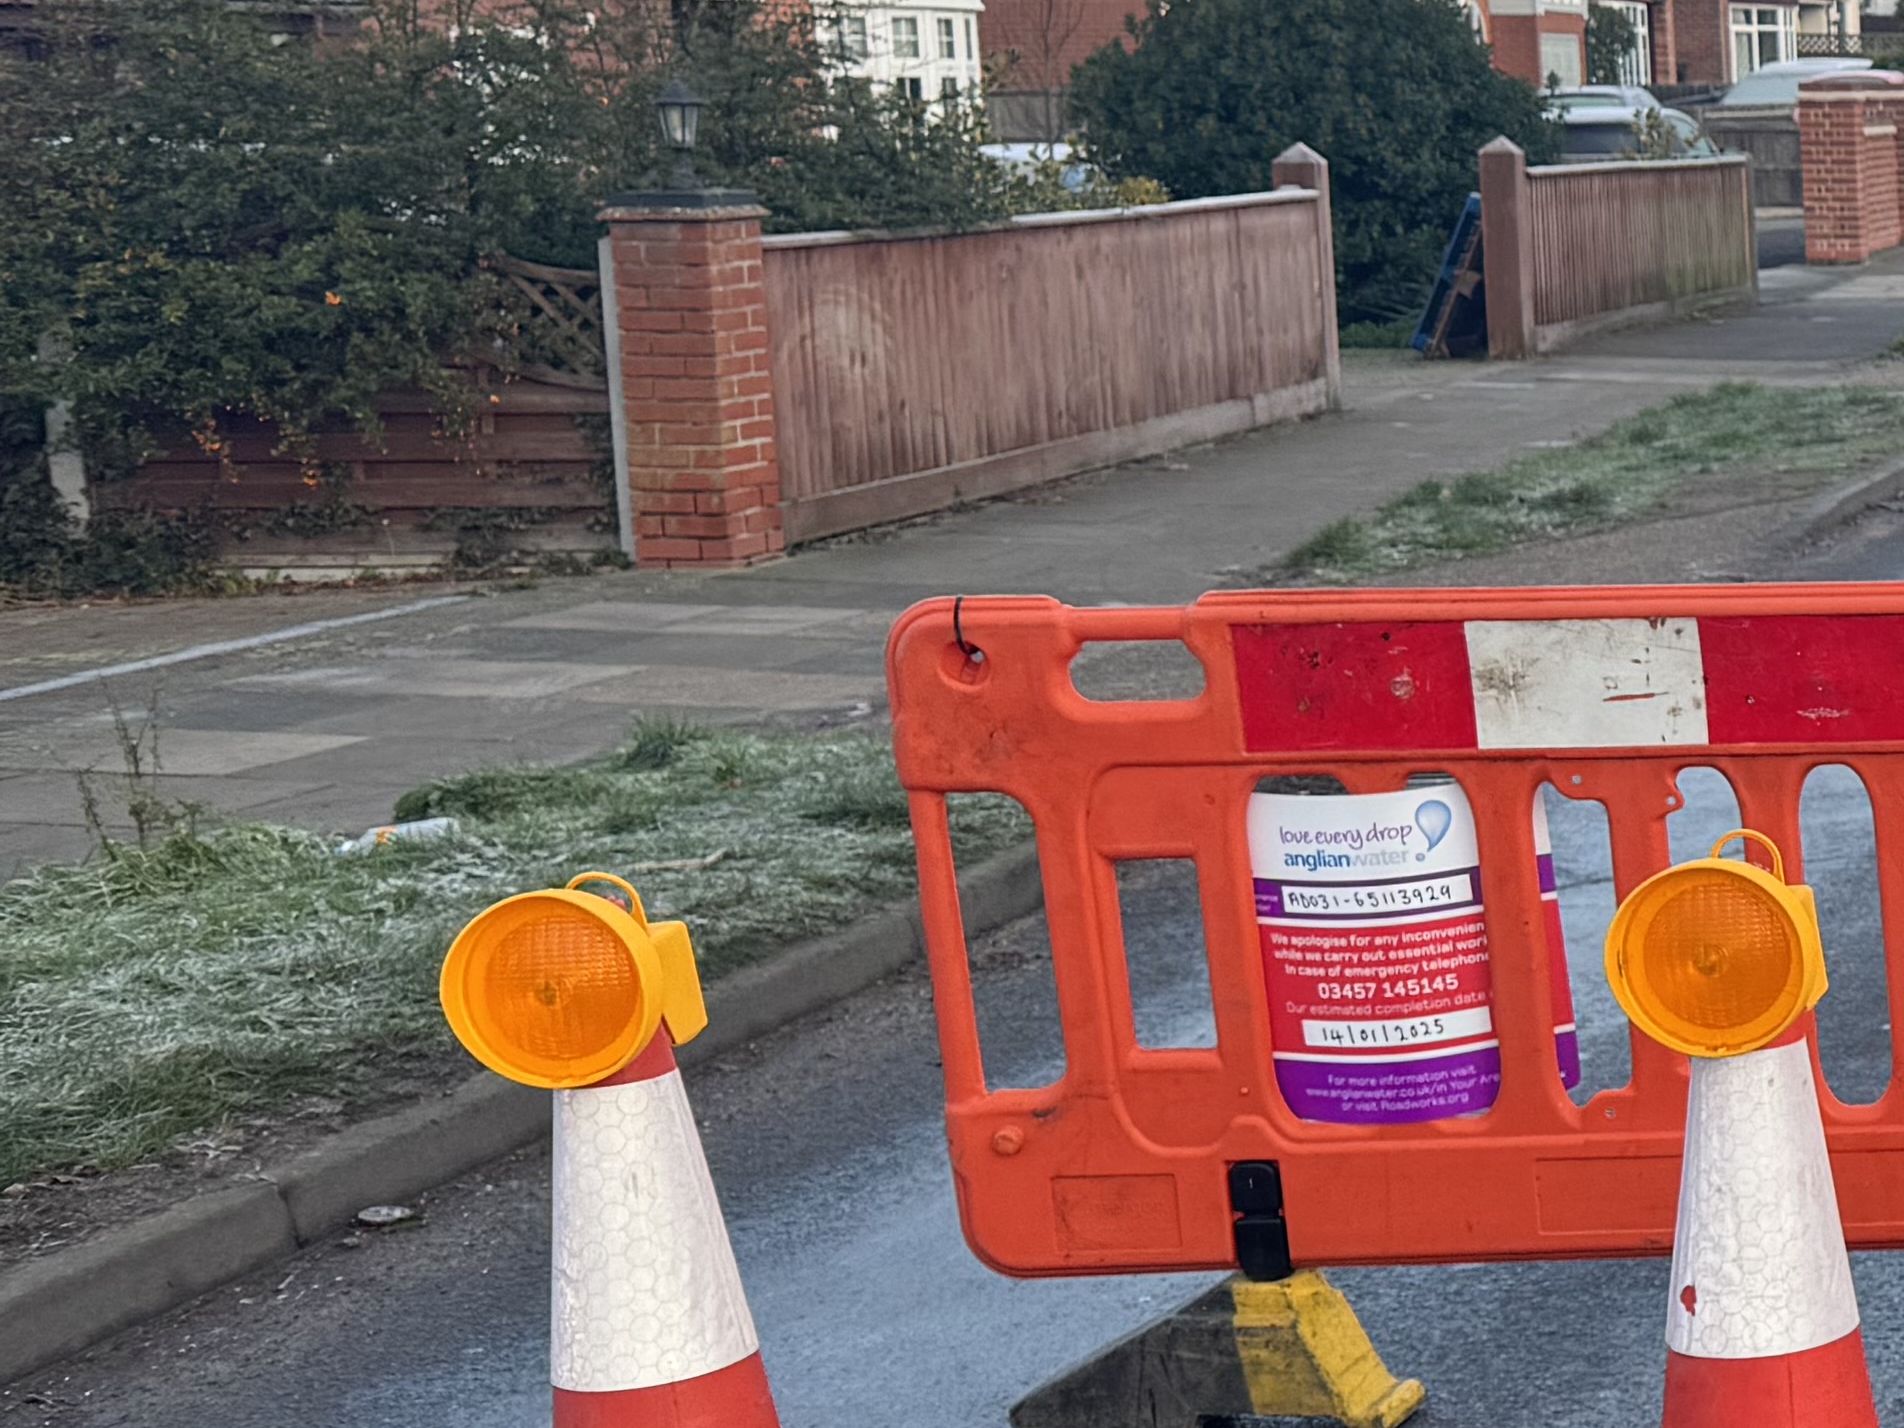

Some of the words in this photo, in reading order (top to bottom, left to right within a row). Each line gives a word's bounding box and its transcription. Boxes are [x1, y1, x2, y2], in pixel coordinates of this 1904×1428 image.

[1279, 825, 1313, 845] love
[1315, 827, 1364, 850] every
[1366, 822, 1413, 846] drop
[1270, 933, 1287, 945] We
[1290, 933, 1348, 949] apologise
[1350, 933, 1370, 947] for
[1374, 934, 1399, 947] any
[1274, 948, 1304, 961] while
[1305, 951, 1322, 961] we
[1324, 951, 1359, 964] carry
[1361, 948, 1386, 961] out
[1388, 940, 1454, 960] essential
[1298, 965, 1326, 977] case
[1327, 964, 1342, 977] of
[1344, 961, 1420, 979] emergency
[1318, 981, 1377, 1000] 03457
[1381, 973, 1459, 999] 145145
[1286, 1000, 1307, 1014] Our
[1309, 1000, 1372, 1016] estimated
[1375, 998, 1451, 1016] completion
[1454, 990, 1486, 1006] date
[1321, 1018, 1444, 1044] 14/01/2025
[1328, 1074, 1345, 1086] For
[1349, 1076, 1377, 1086] more
[1379, 1069, 1449, 1086] information
[1450, 1065, 1477, 1076] visit
[1451, 1078, 1477, 1090] Your
[1341, 1102, 1353, 1111] or
[1355, 1100, 1379, 1111] visit
